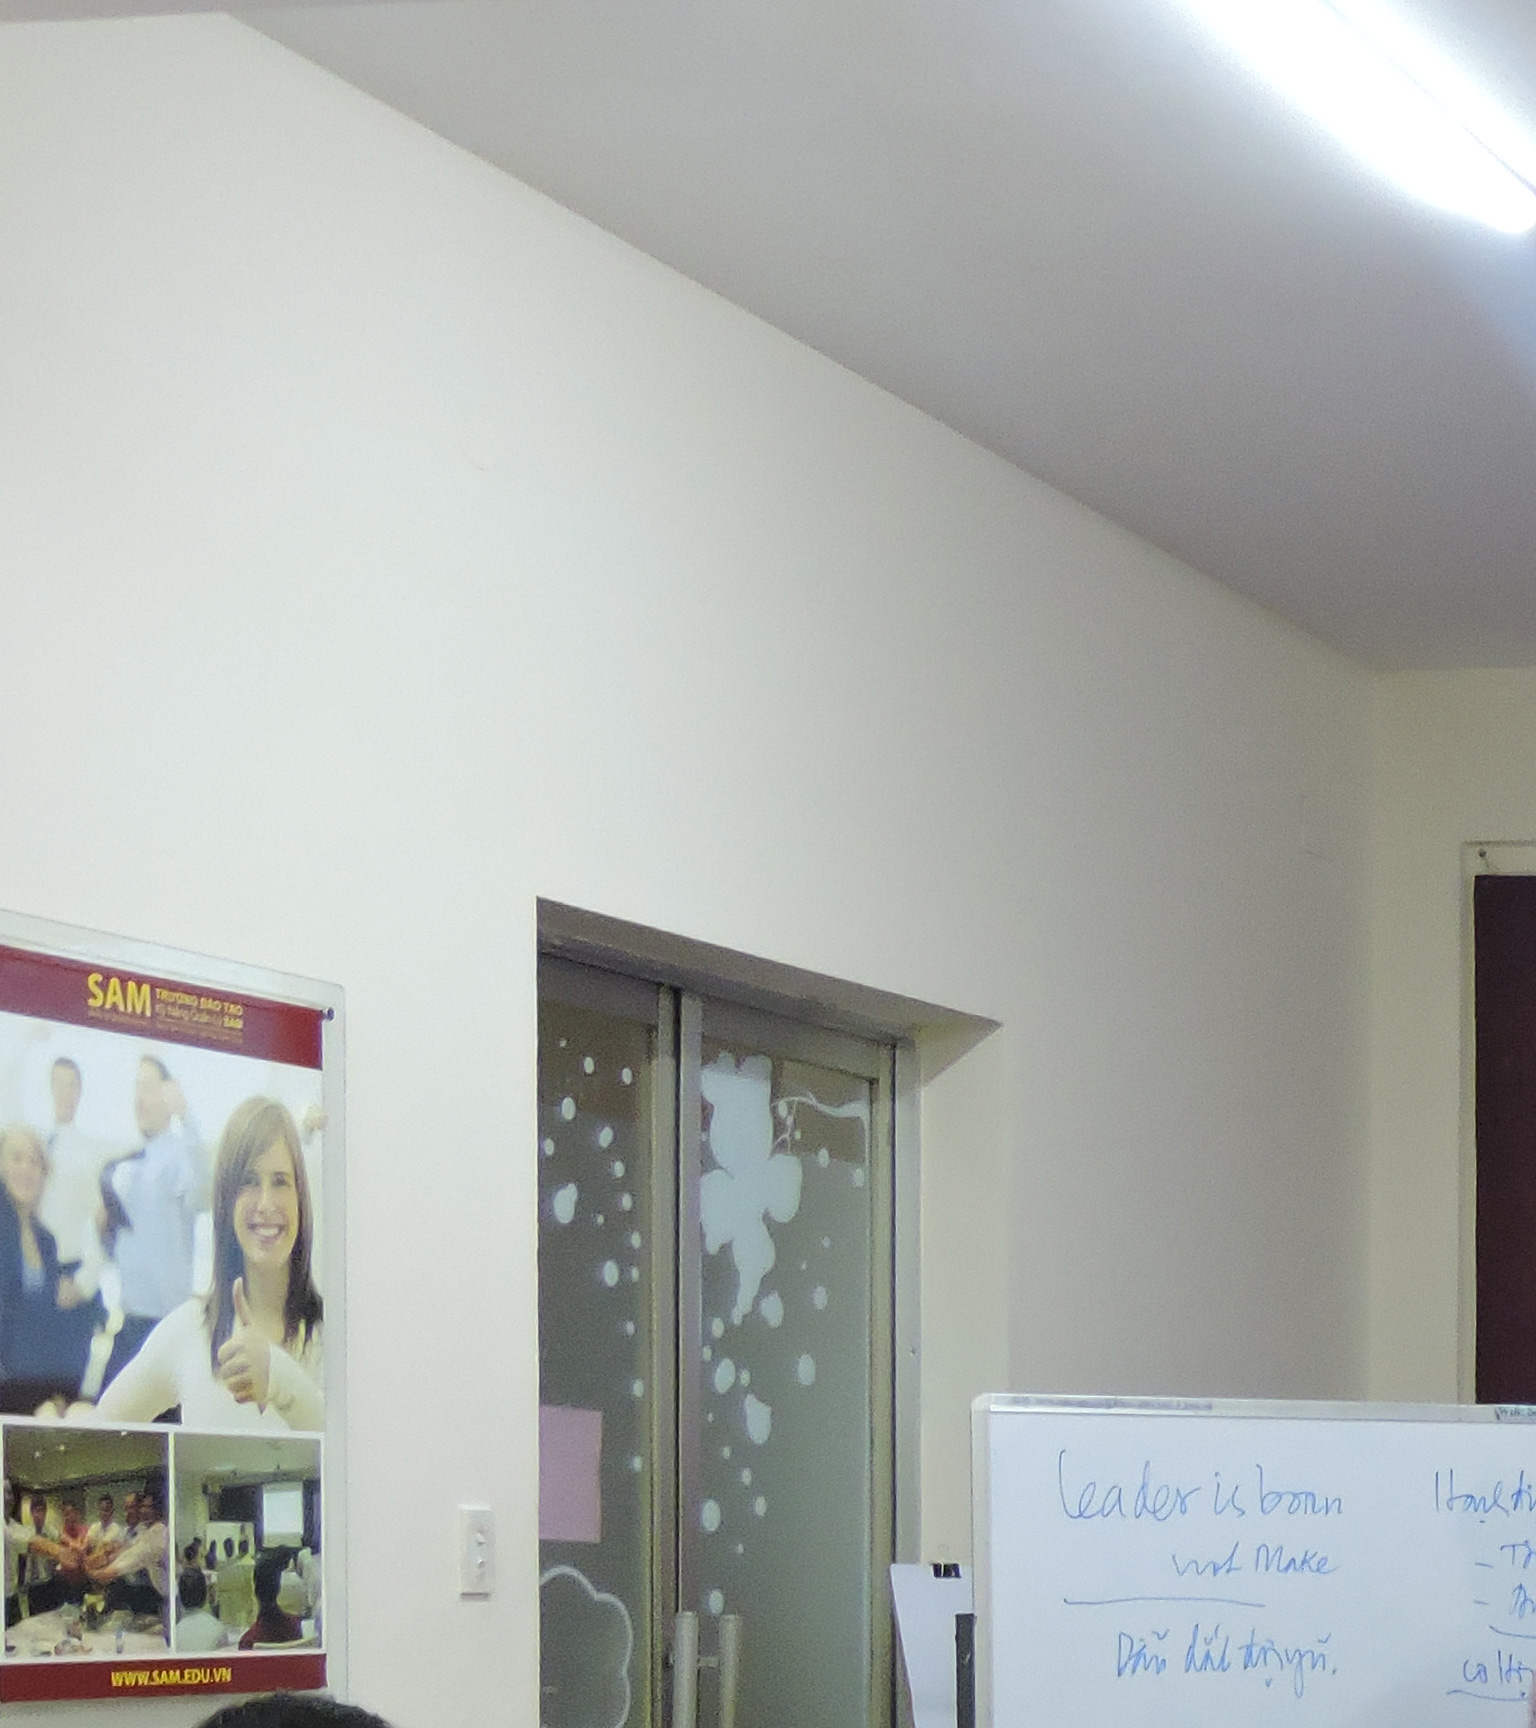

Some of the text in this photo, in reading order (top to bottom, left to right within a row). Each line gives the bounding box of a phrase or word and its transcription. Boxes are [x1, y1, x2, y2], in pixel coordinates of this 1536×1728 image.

[87, 972, 151, 1017] SAM
[1213, 1471, 1246, 1518] is
[111, 1667, 232, 1687] WWW.SAM.EDU.VN
